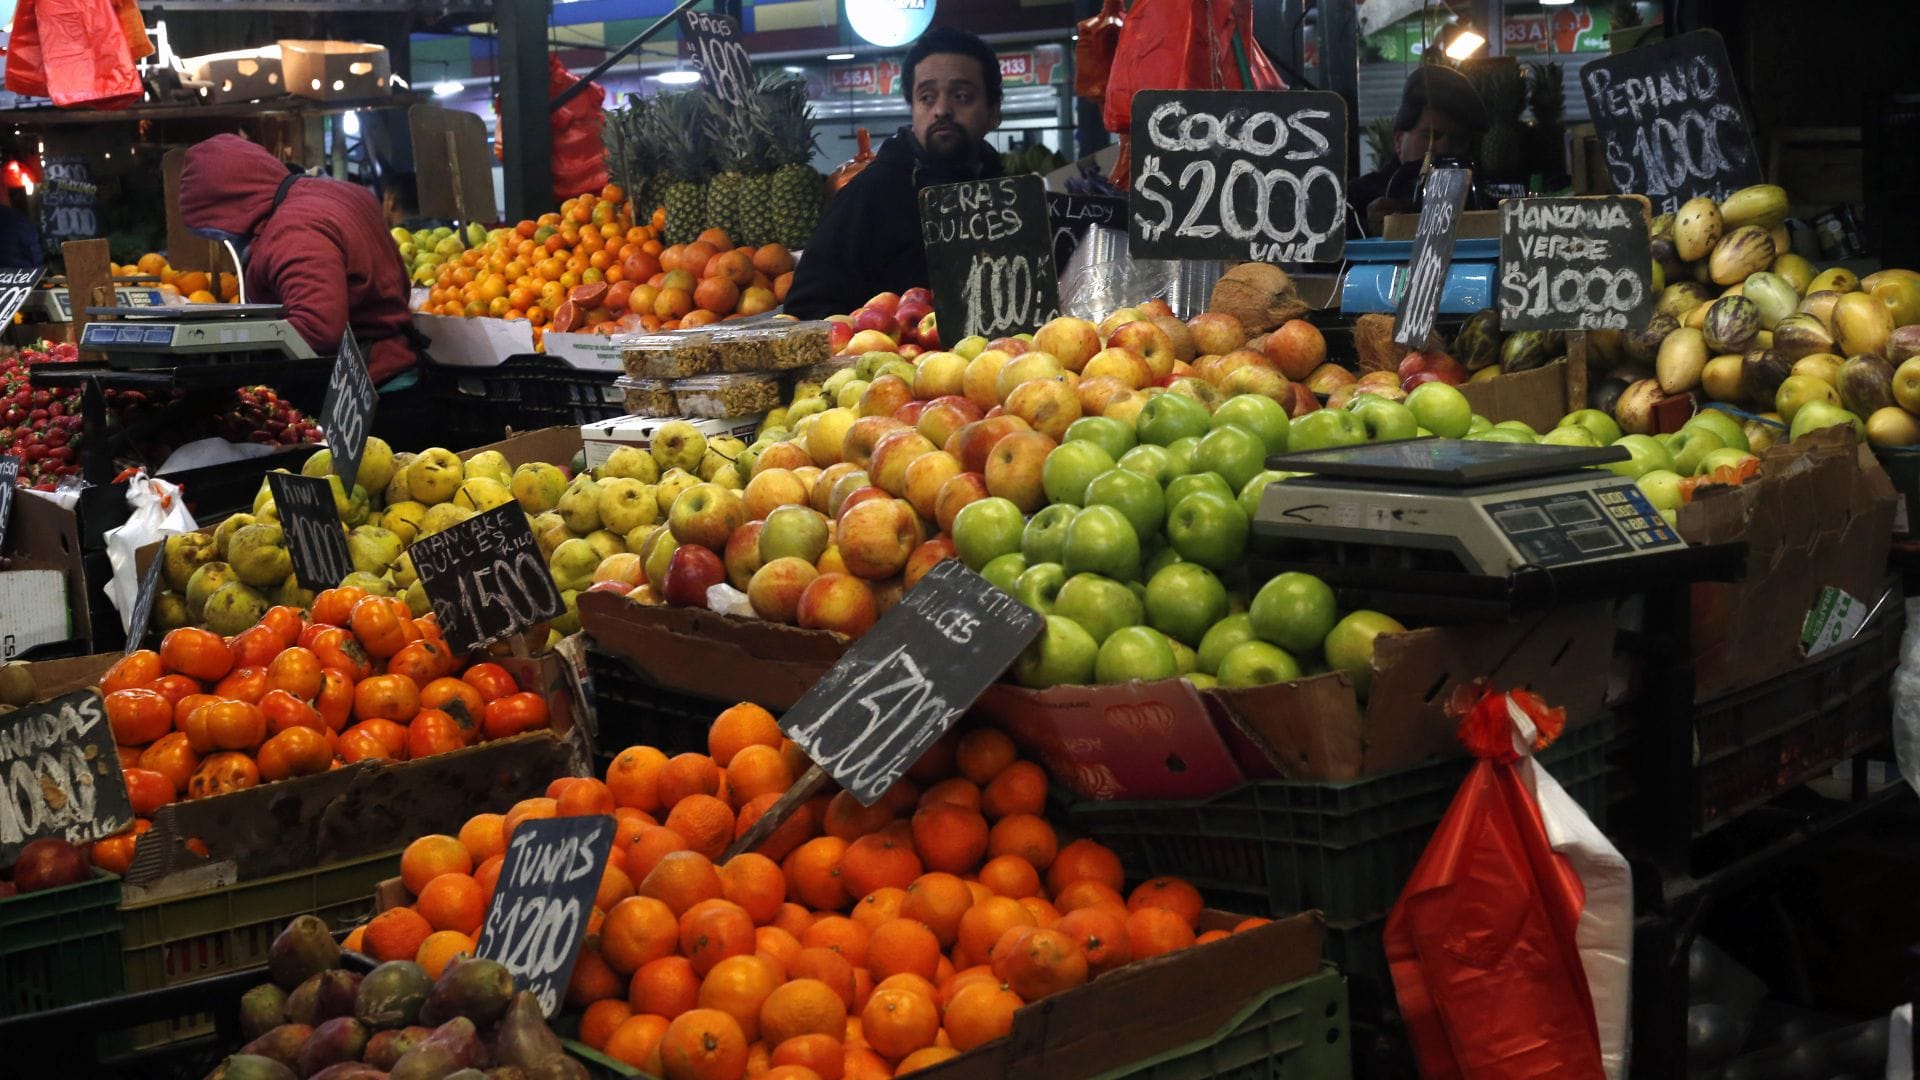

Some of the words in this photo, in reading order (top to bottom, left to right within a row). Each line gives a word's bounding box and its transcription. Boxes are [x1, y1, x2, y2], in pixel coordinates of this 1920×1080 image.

[1588, 55, 1719, 119] PEPINO
[1134, 155, 1347, 243] $2000
[1518, 234, 1612, 263] VERDE
[1500, 260, 1644, 320] $1000
[0, 695, 102, 763] NADAS
